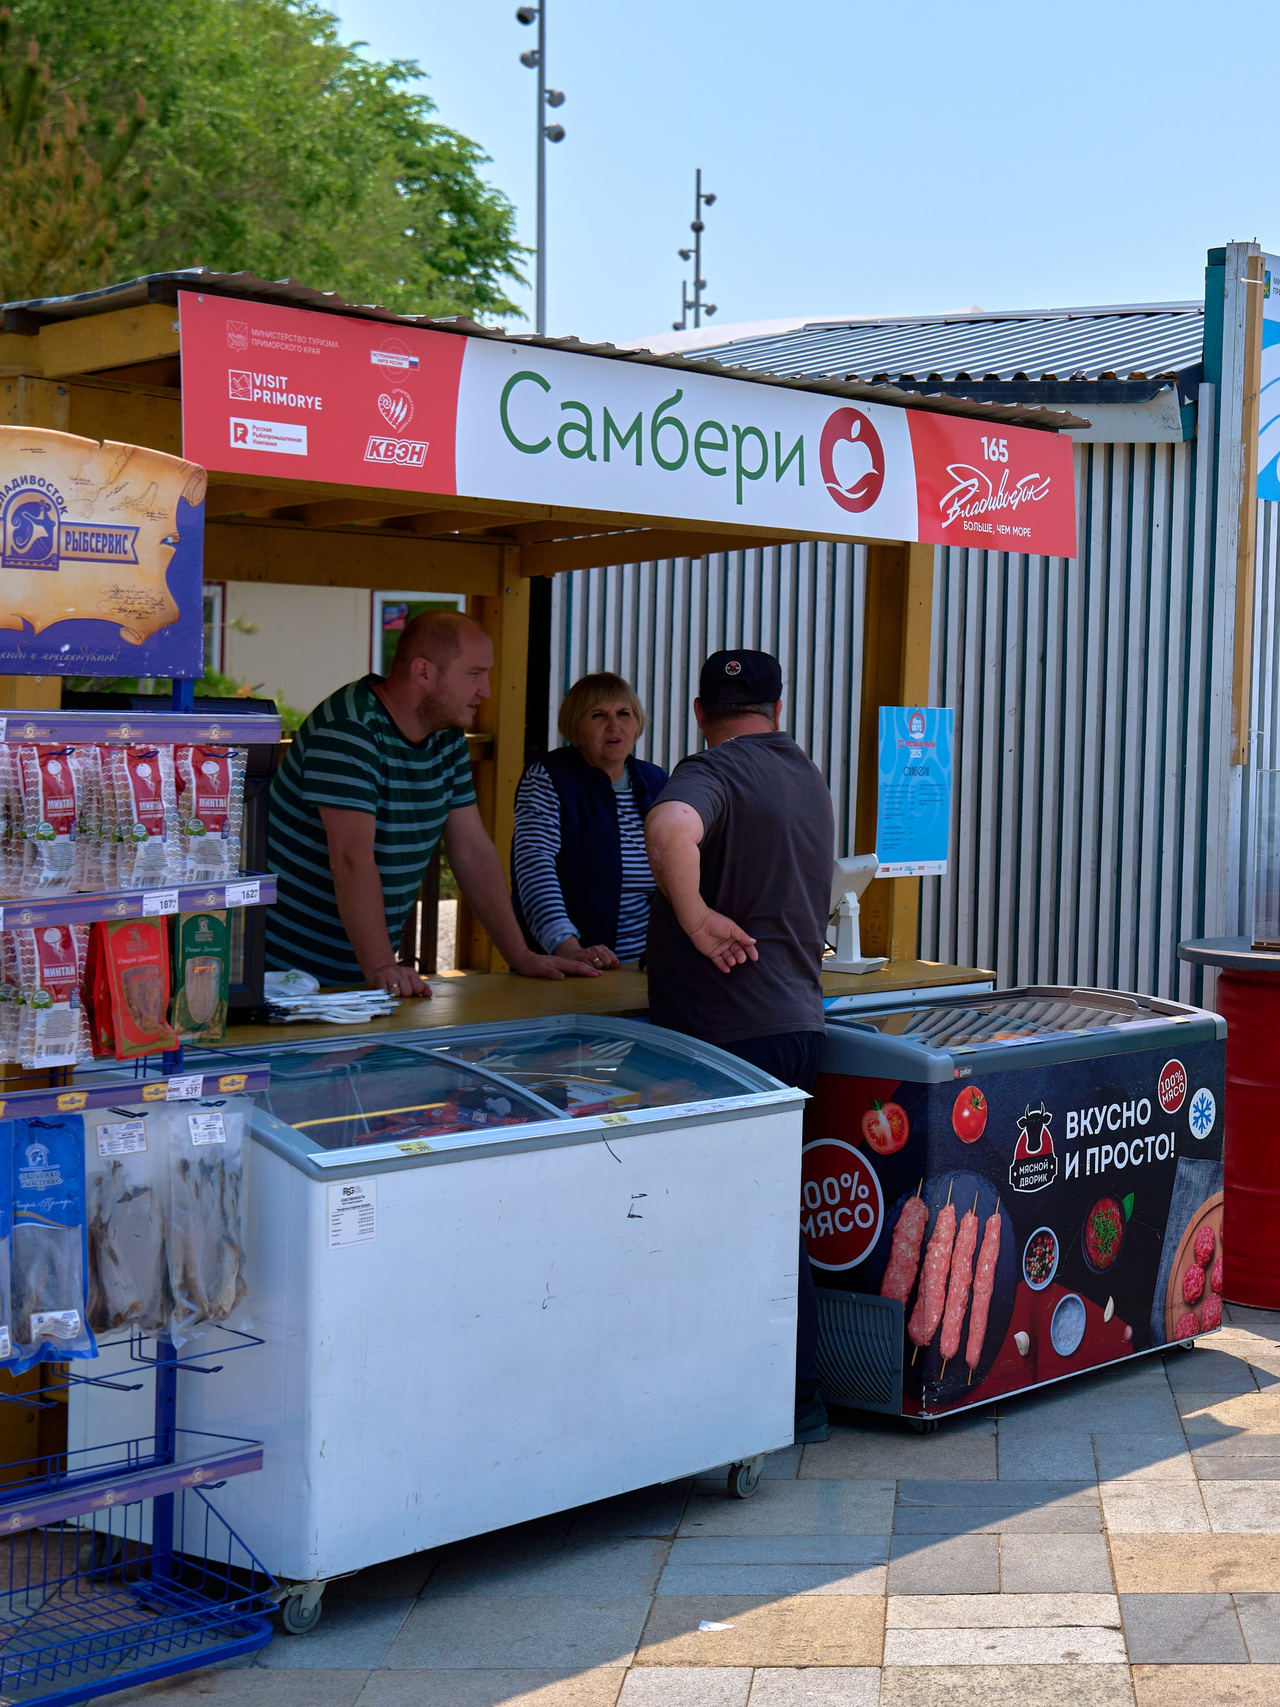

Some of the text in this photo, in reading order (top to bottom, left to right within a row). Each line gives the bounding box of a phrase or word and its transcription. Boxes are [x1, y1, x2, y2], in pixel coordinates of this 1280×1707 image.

[251, 329, 340, 349] МИНИСТЕРСТВО ТУРИЗМА
[251, 338, 321, 356] ПРИМОРСКОГО КРАЯ
[253, 372, 288, 390] VISIT
[253, 388, 323, 410] PRIMORYE
[500, 370, 806, 505] Самбери
[368, 440, 424, 462] КВЭН
[981, 436, 1009, 463] 165
[963, 520, 1031, 538] БОЛЬШЕ, ЧЕМ МОРЕ
[65, 530, 128, 555] РЫБСЕРВИС
[47, 798, 74, 809] МИНТАЙ
[160, 900, 173, 910] 187
[43, 965, 76, 978] МИНТАЙ
[185, 1086, 197, 1096] 539
[1161, 1070, 1184, 1094] 100%
[1162, 1082, 1185, 1105] МЯСО
[1066, 1097, 1152, 1140] ВКУСНО
[1065, 1132, 1176, 1180] И ПРОСТО!
[1019, 1158, 1049, 1175] МЯСНОЙ
[1019, 1173, 1048, 1189] ДВОРИК
[342, 1186, 355, 1196] RSG
